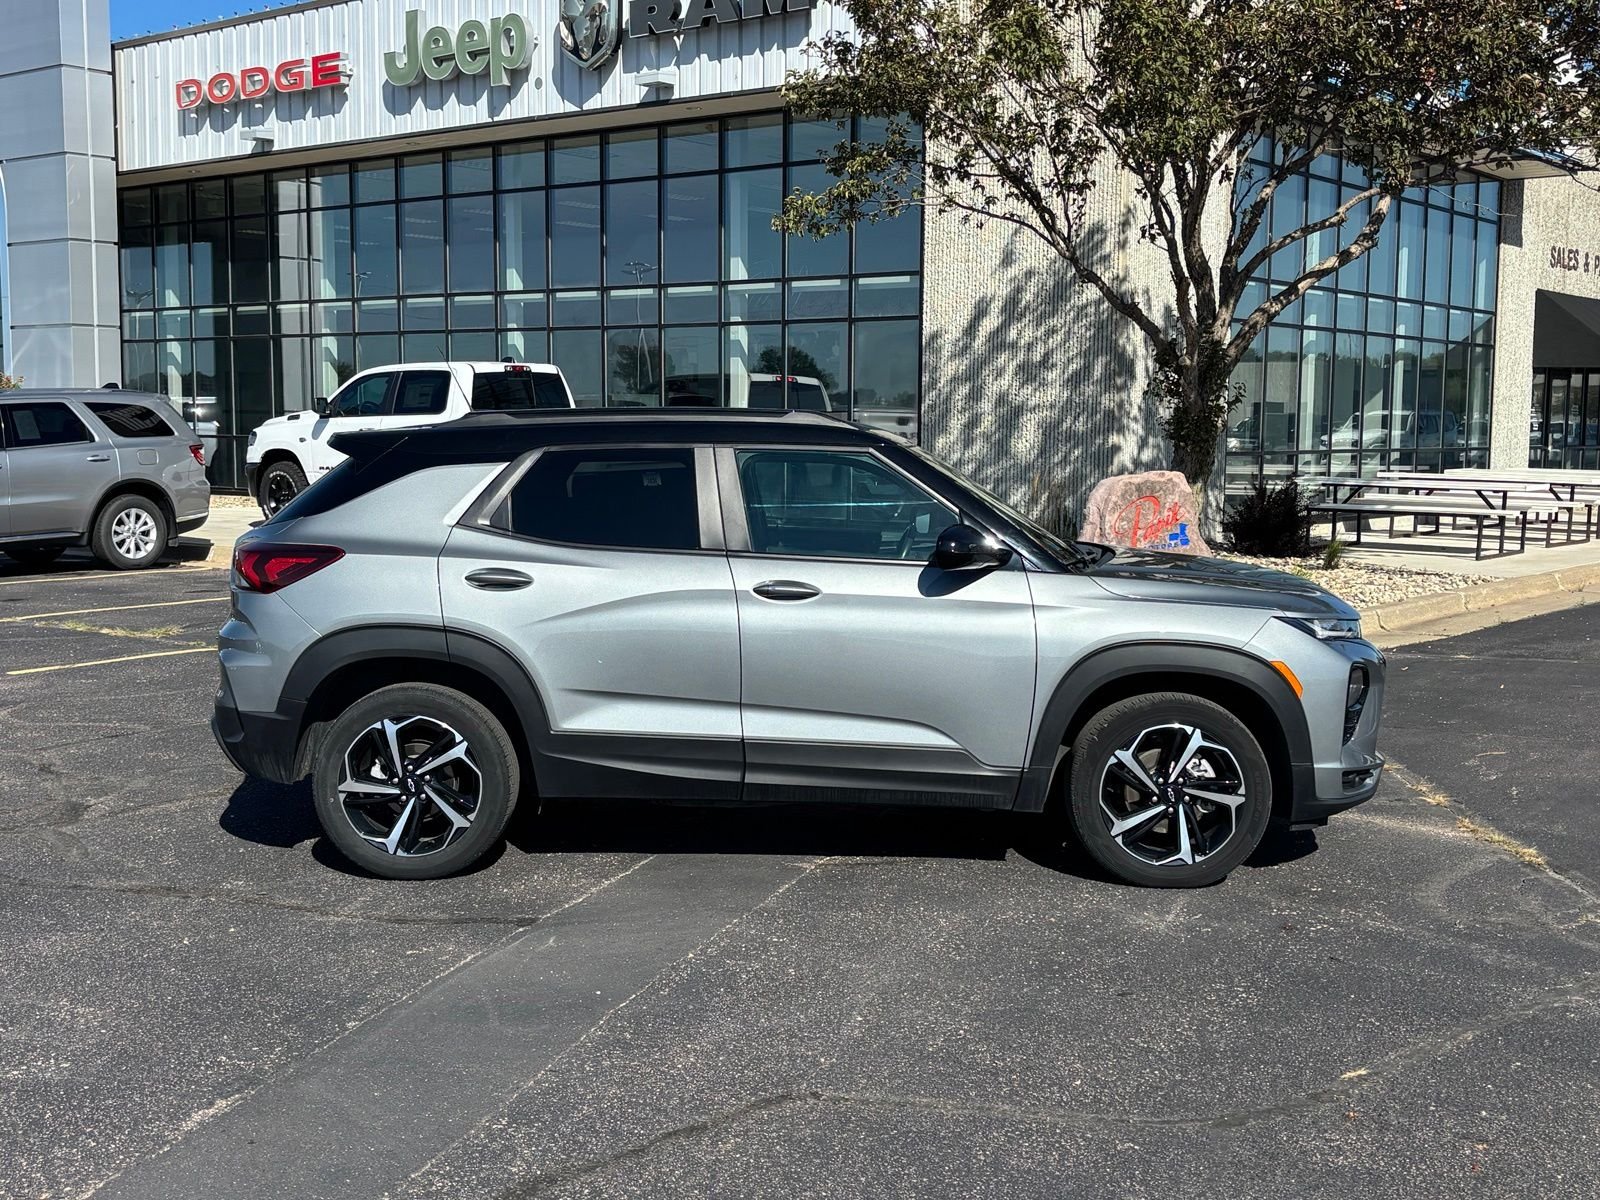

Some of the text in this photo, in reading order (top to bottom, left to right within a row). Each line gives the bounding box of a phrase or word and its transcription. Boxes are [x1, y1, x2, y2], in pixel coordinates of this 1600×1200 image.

[384, 9, 530, 87] Jeep
[176, 52, 344, 110] DODGE
[1549, 245, 1600, 276] SALES & P
